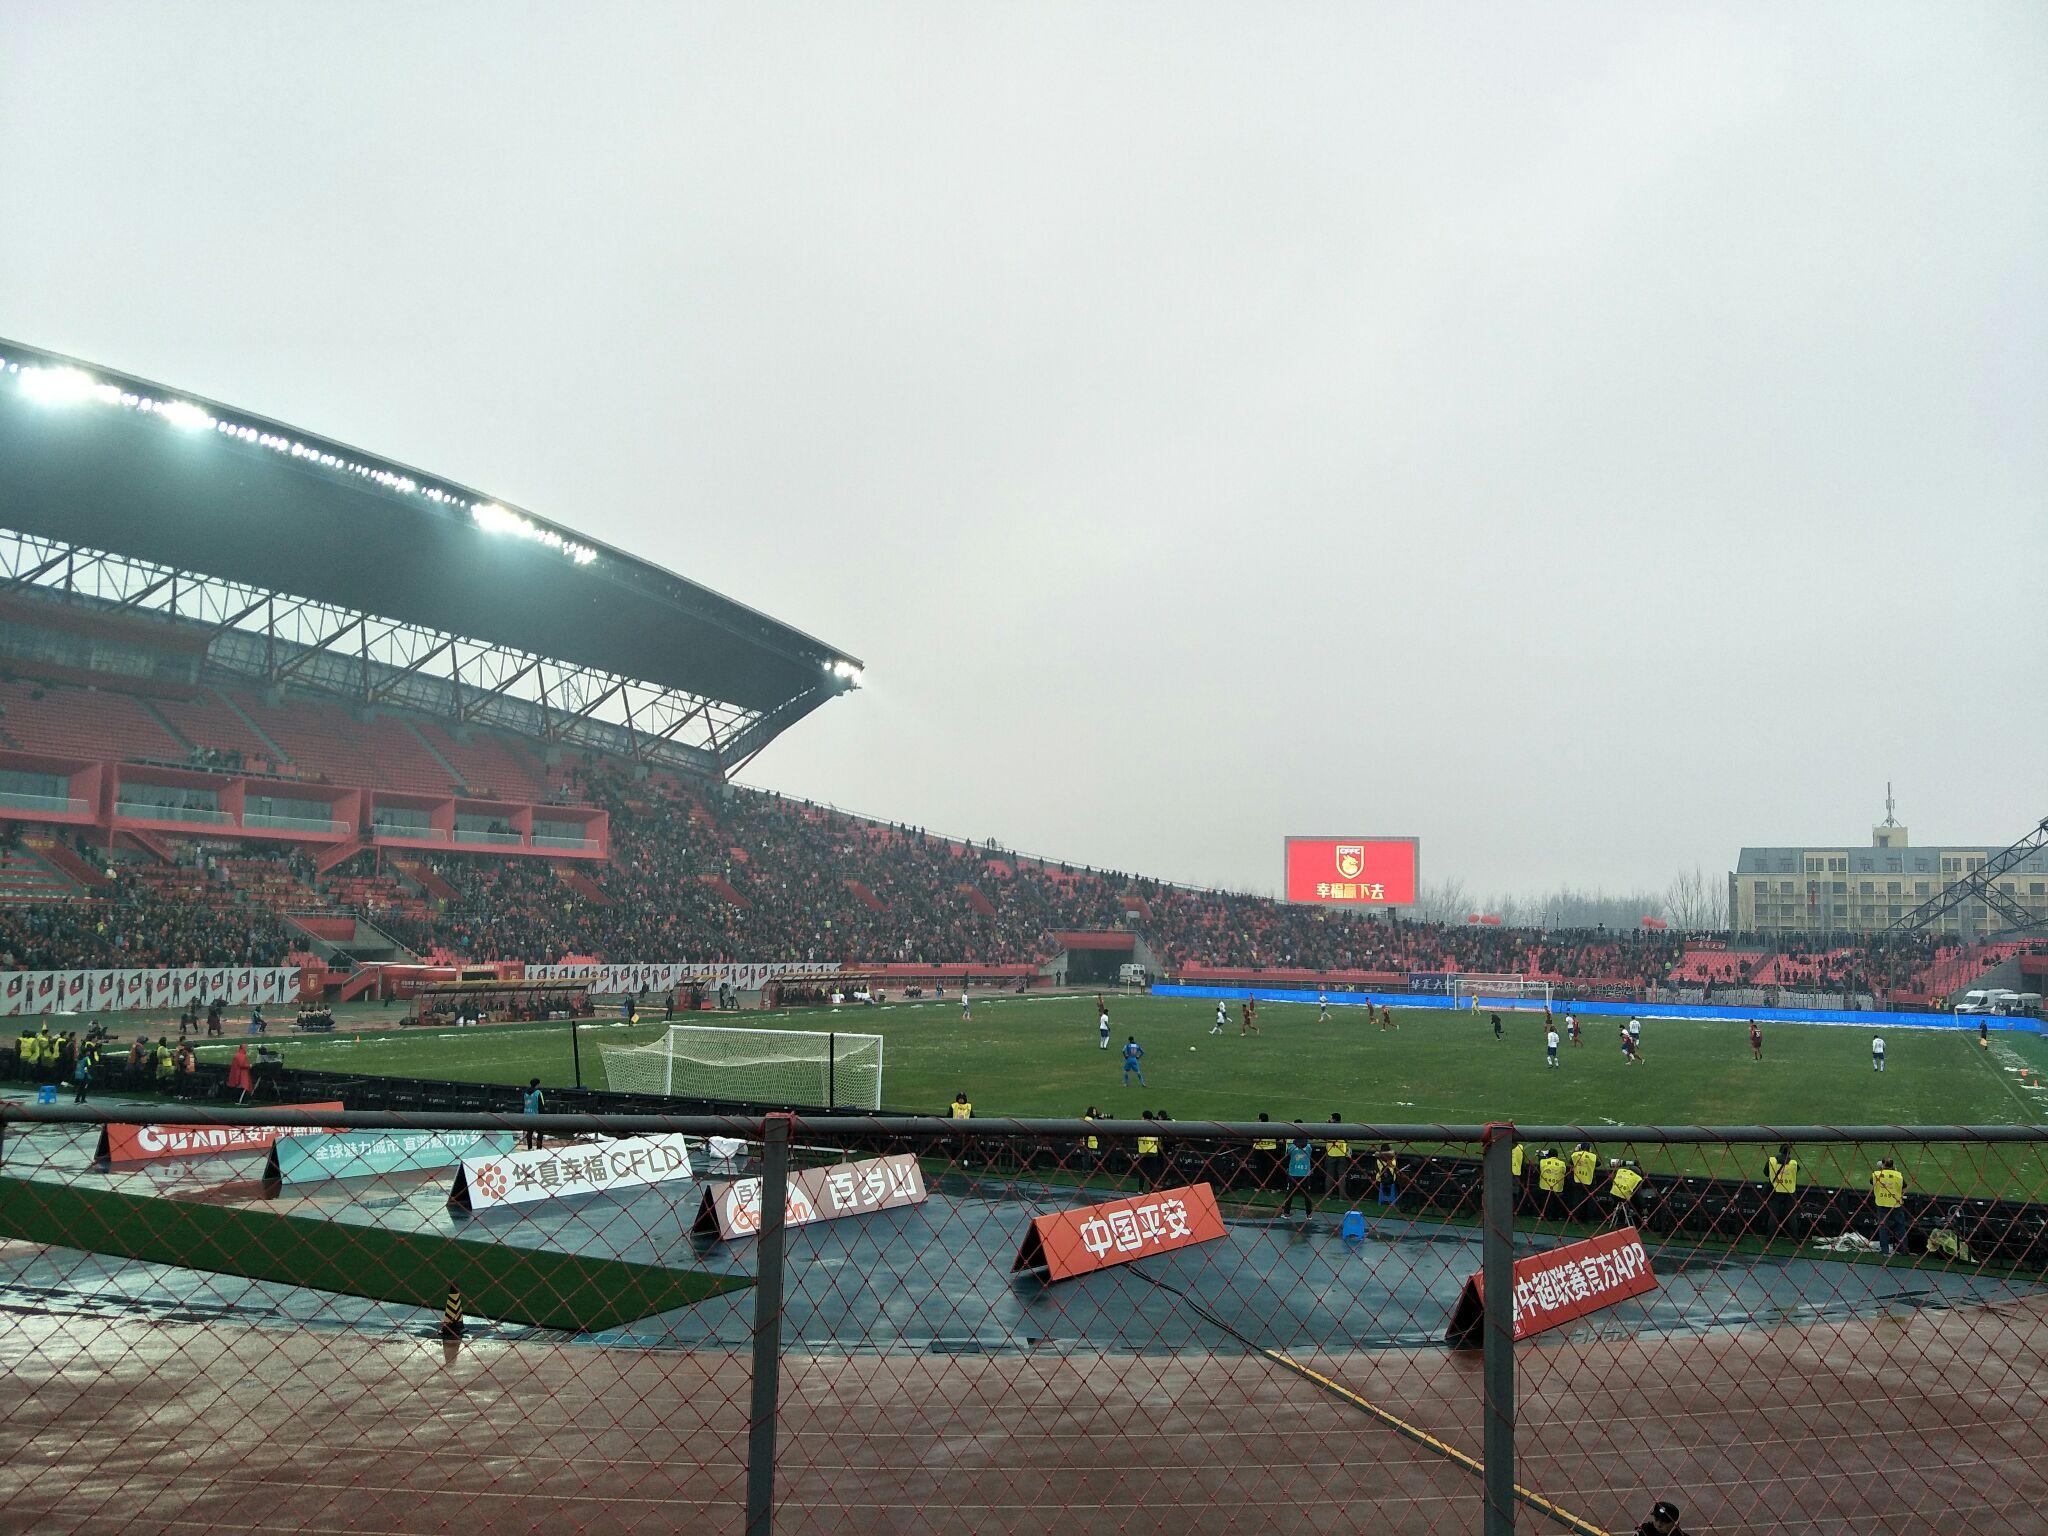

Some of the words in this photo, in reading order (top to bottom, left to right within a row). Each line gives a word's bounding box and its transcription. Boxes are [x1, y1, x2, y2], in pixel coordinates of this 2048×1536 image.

[1316, 882, 1385, 900] 幸福赢下去
[512, 1156, 608, 1191] 华夏幸福
[610, 1145, 682, 1178] CFLD
[826, 1163, 918, 1210] 百岁山
[1080, 1198, 1191, 1258] 中国平安
